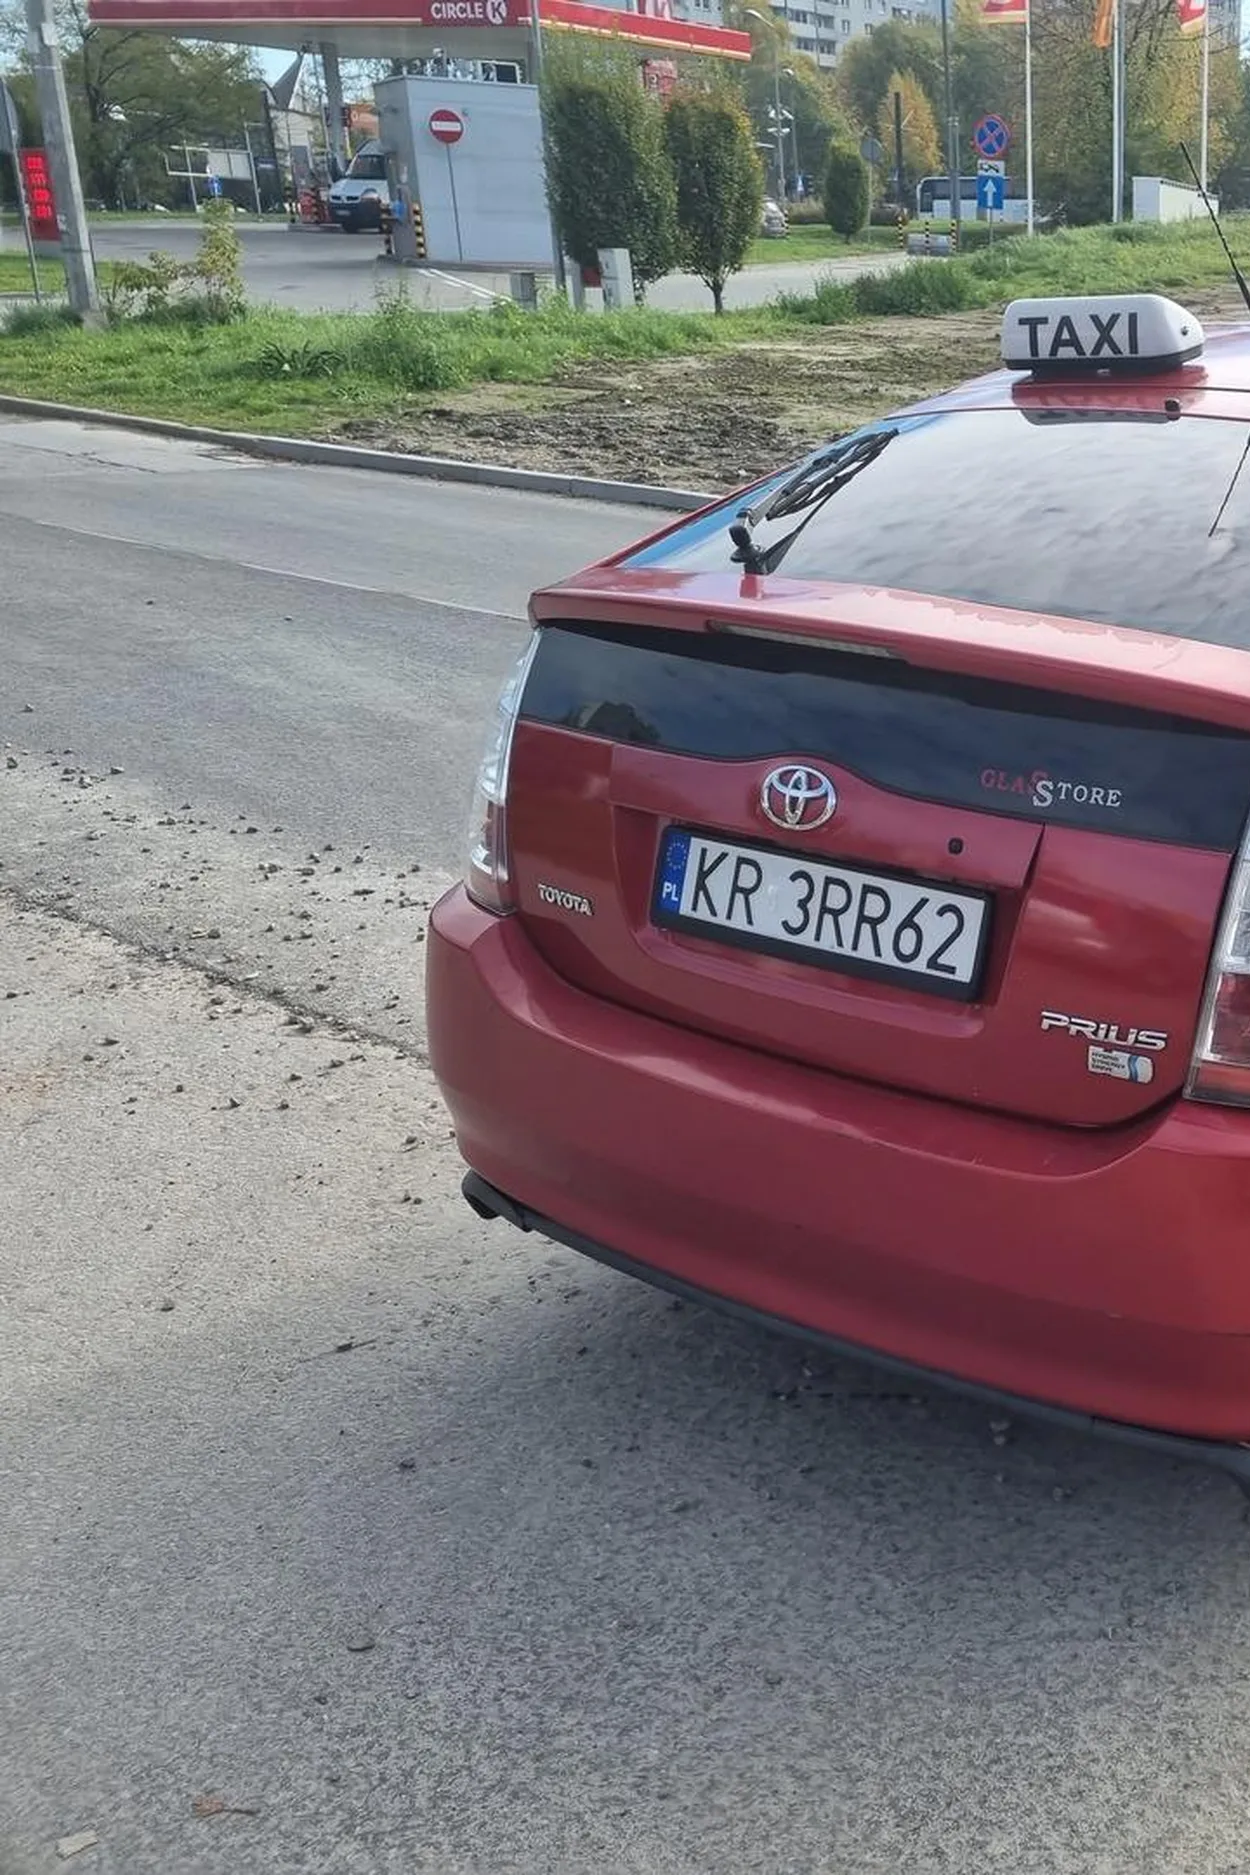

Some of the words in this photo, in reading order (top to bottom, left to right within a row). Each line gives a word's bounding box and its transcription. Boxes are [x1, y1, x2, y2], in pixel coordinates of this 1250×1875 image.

[430, 2, 484, 19] CIRCLE
[486, 0, 507, 25] K
[1018, 312, 1139, 358] TAXI
[538, 883, 593, 916] TOYOTA
[662, 881, 679, 902] PL
[691, 847, 763, 926] KR
[781, 869, 965, 975] 3RR62
[1041, 1011, 1168, 1051] PRIUS
